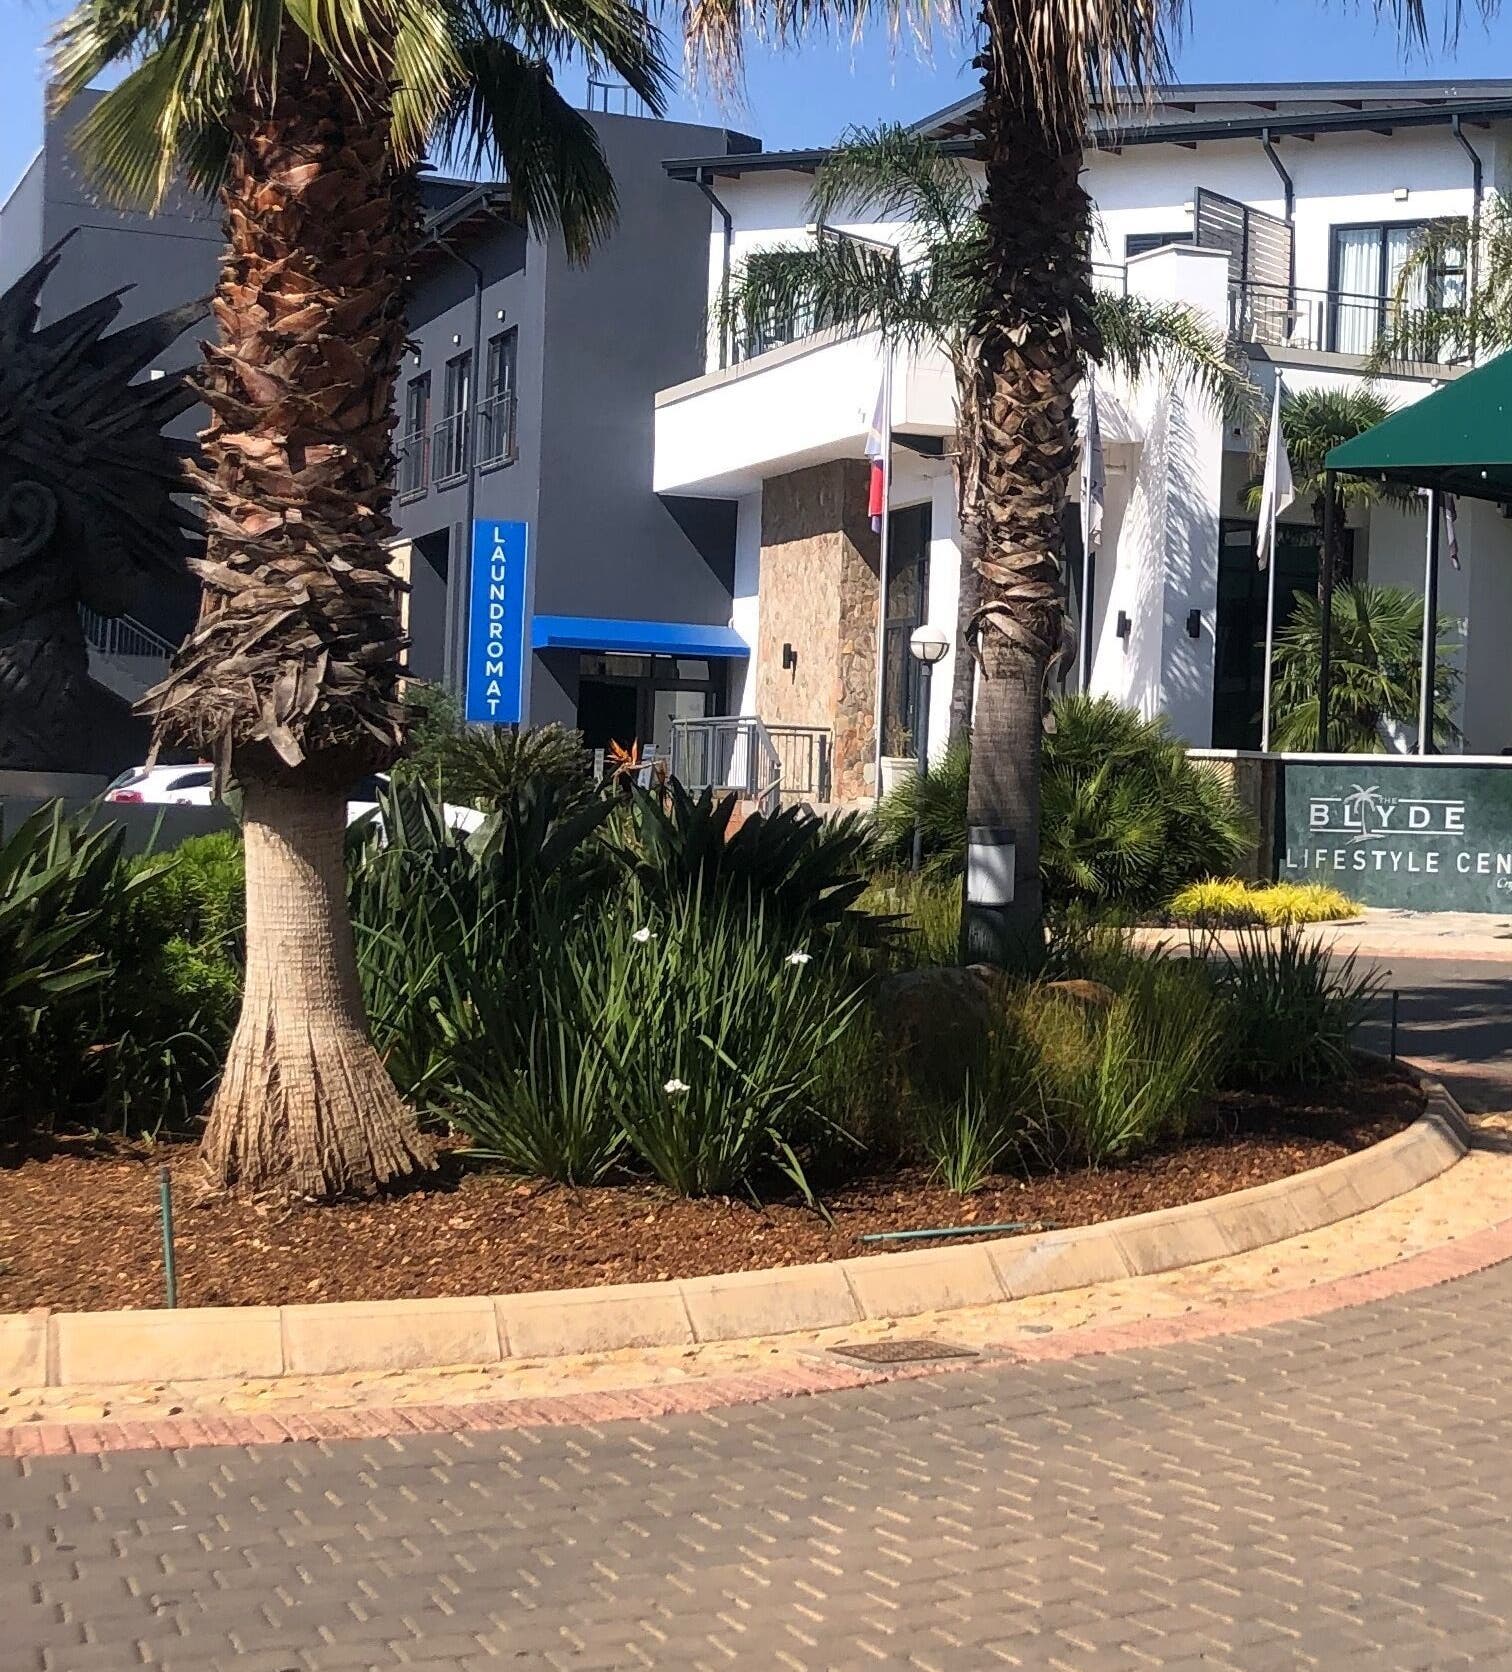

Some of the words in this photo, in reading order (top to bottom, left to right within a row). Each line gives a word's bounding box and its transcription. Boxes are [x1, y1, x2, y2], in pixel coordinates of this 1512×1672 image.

[485, 526, 506, 716] LAUNDROMAT
[1310, 804, 1465, 829] BLYDE
[1286, 848, 1440, 873] LIFESTYLE
